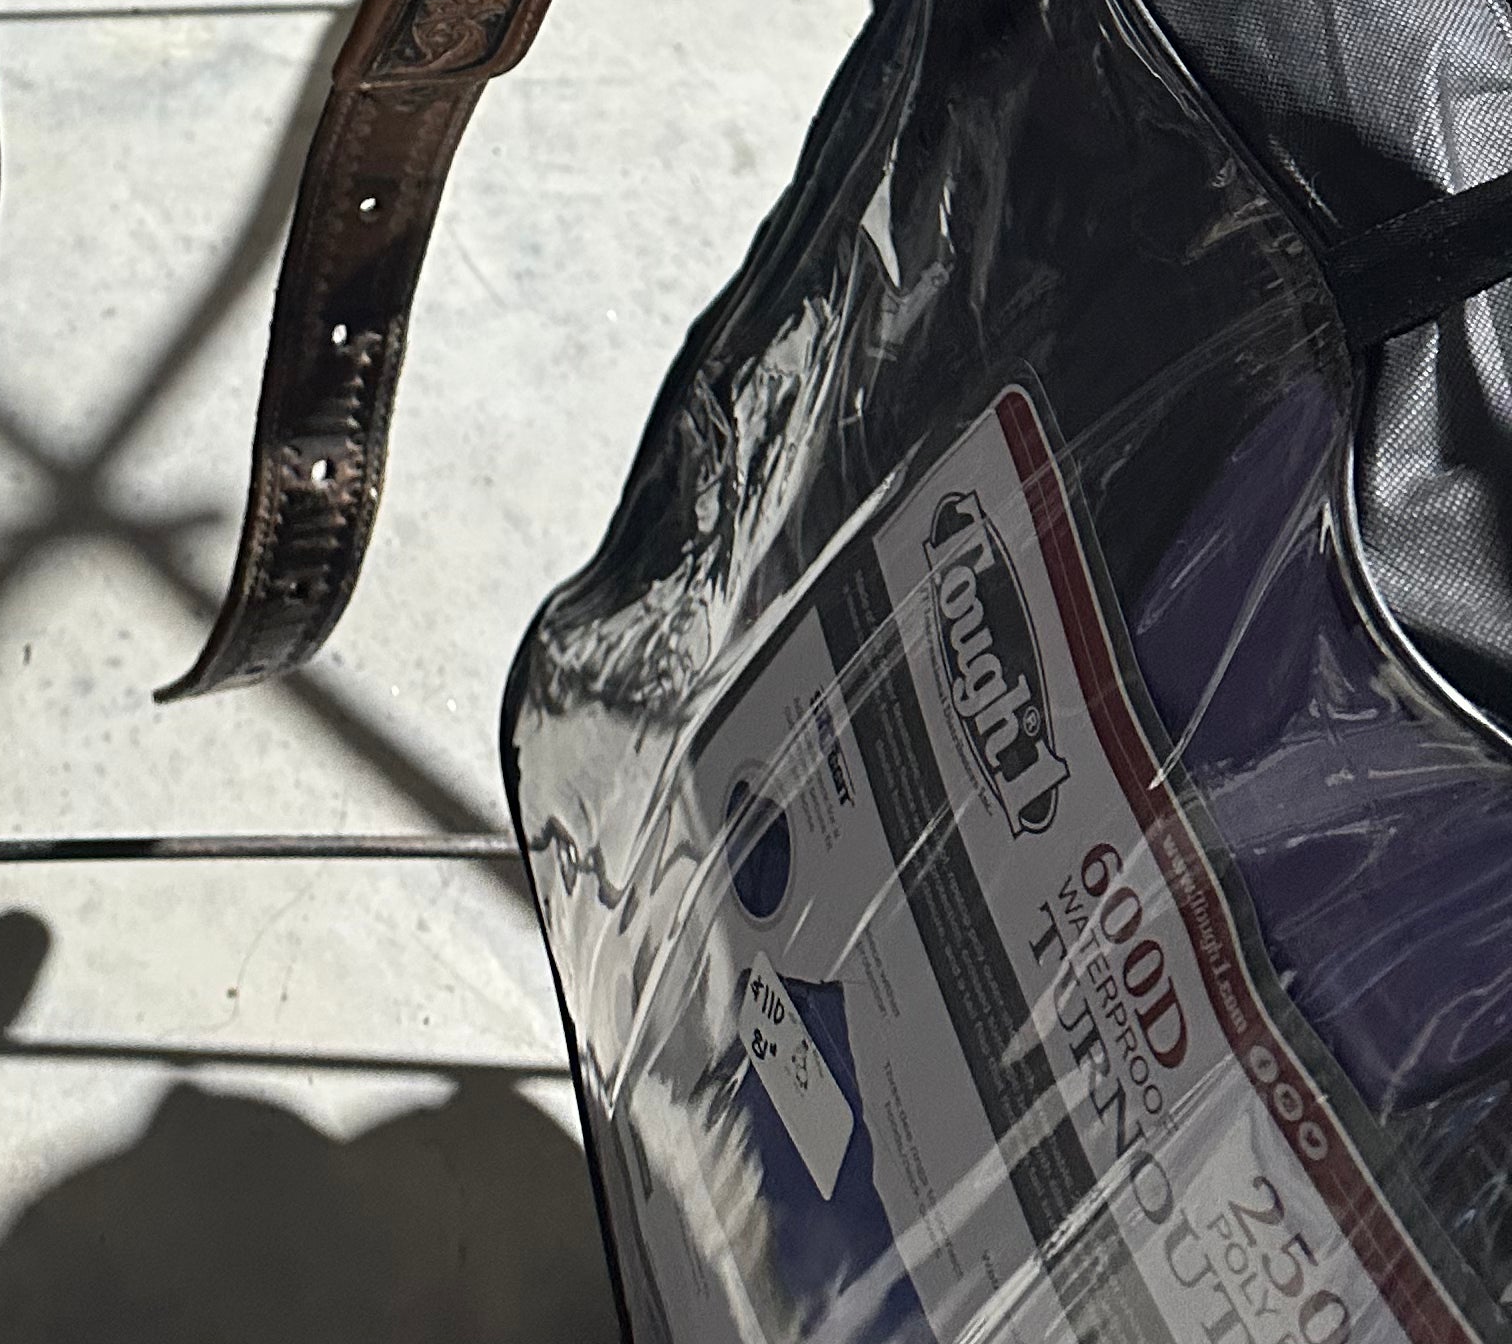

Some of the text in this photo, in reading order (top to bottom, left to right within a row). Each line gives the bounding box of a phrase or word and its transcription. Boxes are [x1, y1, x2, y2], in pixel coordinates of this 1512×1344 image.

[1057, 874, 1179, 1134] WATERPROOF
[1080, 842, 1187, 1070] 600D
[1029, 900, 1255, 1344] TURNOUT
[1206, 1213, 1281, 1317] POLY
[1228, 1175, 1351, 1344] 250
